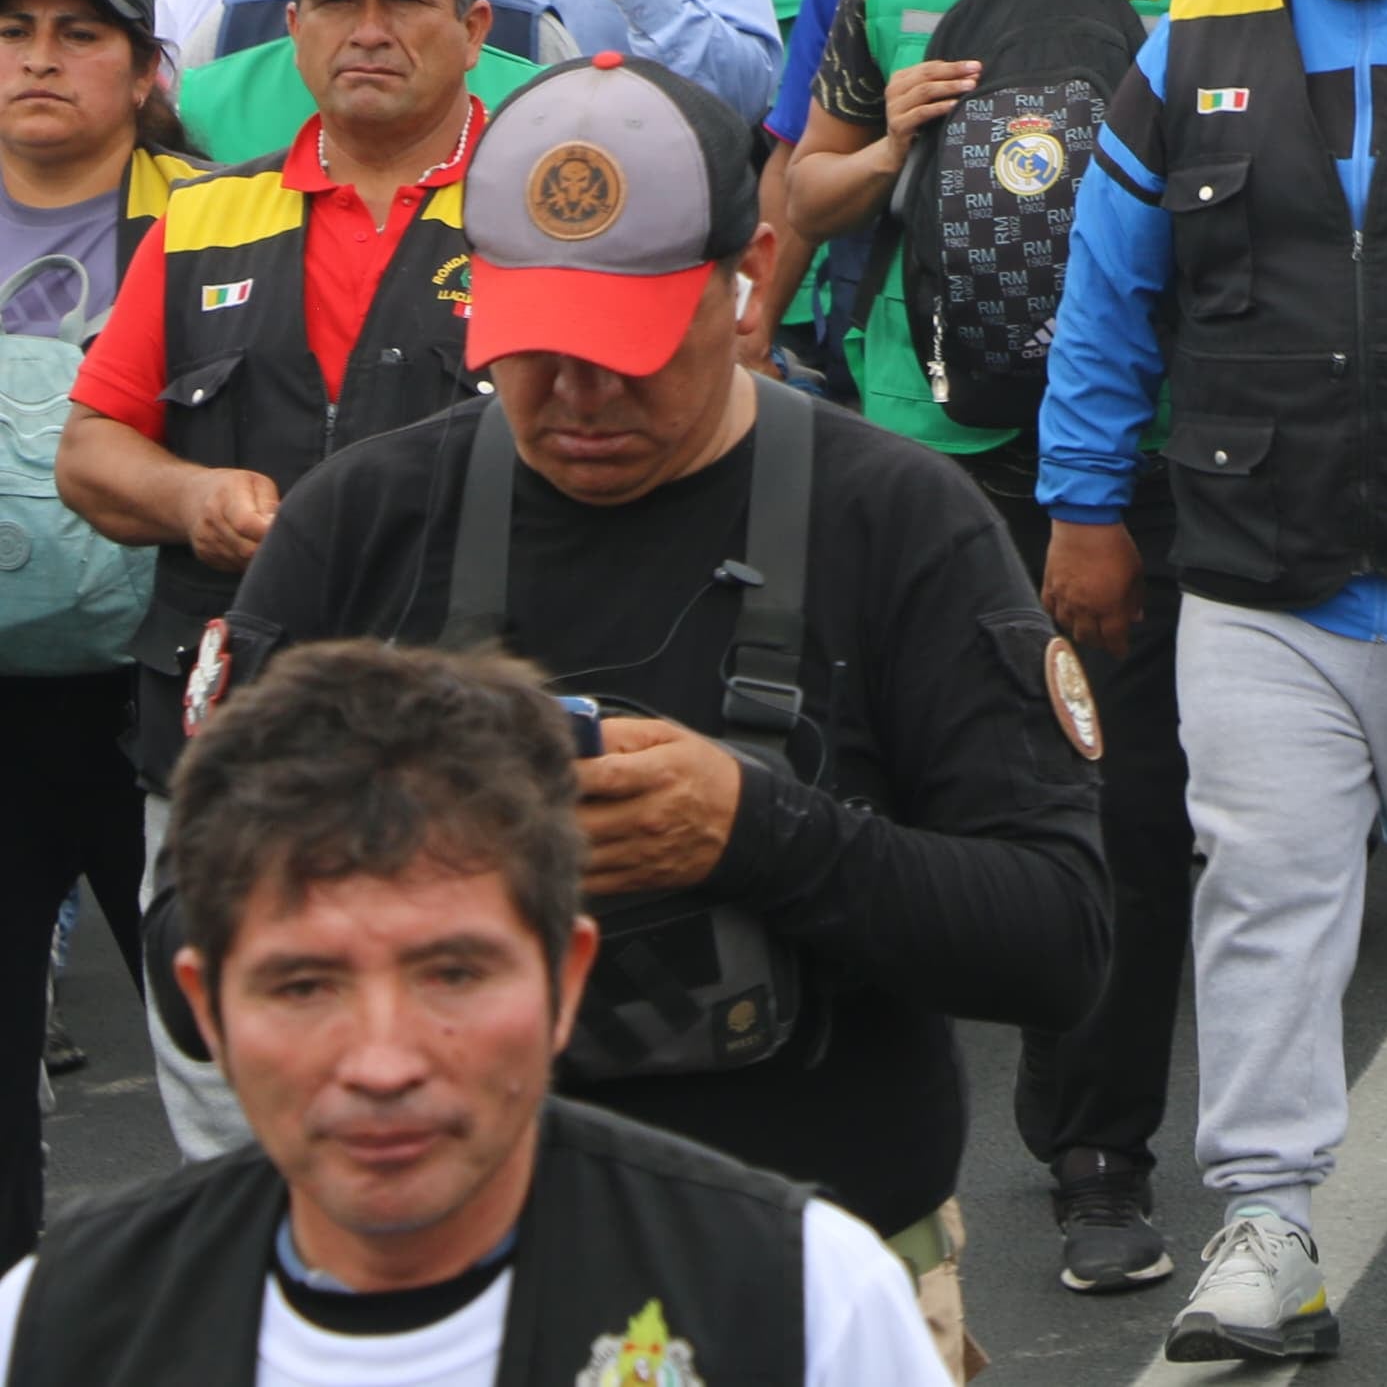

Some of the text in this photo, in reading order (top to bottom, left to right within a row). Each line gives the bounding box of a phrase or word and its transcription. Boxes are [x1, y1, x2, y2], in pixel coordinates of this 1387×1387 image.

[965, 99, 994, 113] RM
[1015, 94, 1044, 107] RM
[966, 112, 993, 122] 1902
[1091, 98, 1105, 124] RM
[991, 117, 1006, 143] RM
[1065, 126, 1092, 142] RM
[962, 145, 990, 159] RM
[1067, 140, 1094, 152] 1902
[964, 158, 990, 168] 1902
[941, 170, 954, 196] RM
[965, 193, 993, 209] RM
[1018, 202, 1046, 215] 1902
[968, 207, 993, 220] 1902
[943, 221, 970, 237] RM
[994, 216, 1011, 245] RM
[1010, 215, 1022, 242] 1902
[944, 236, 970, 248] 1902
[1023, 239, 1053, 257] RM
[968, 248, 997, 264] RM
[1026, 255, 1053, 268] 1902
[432, 254, 470, 285] RONDA
[970, 262, 997, 276] 1902
[999, 270, 1029, 286] RM
[949, 275, 965, 303] RM
[1002, 285, 1029, 297] 1902
[977, 301, 1005, 315] RM
[1027, 296, 1057, 312] RM
[958, 326, 985, 340] RM
